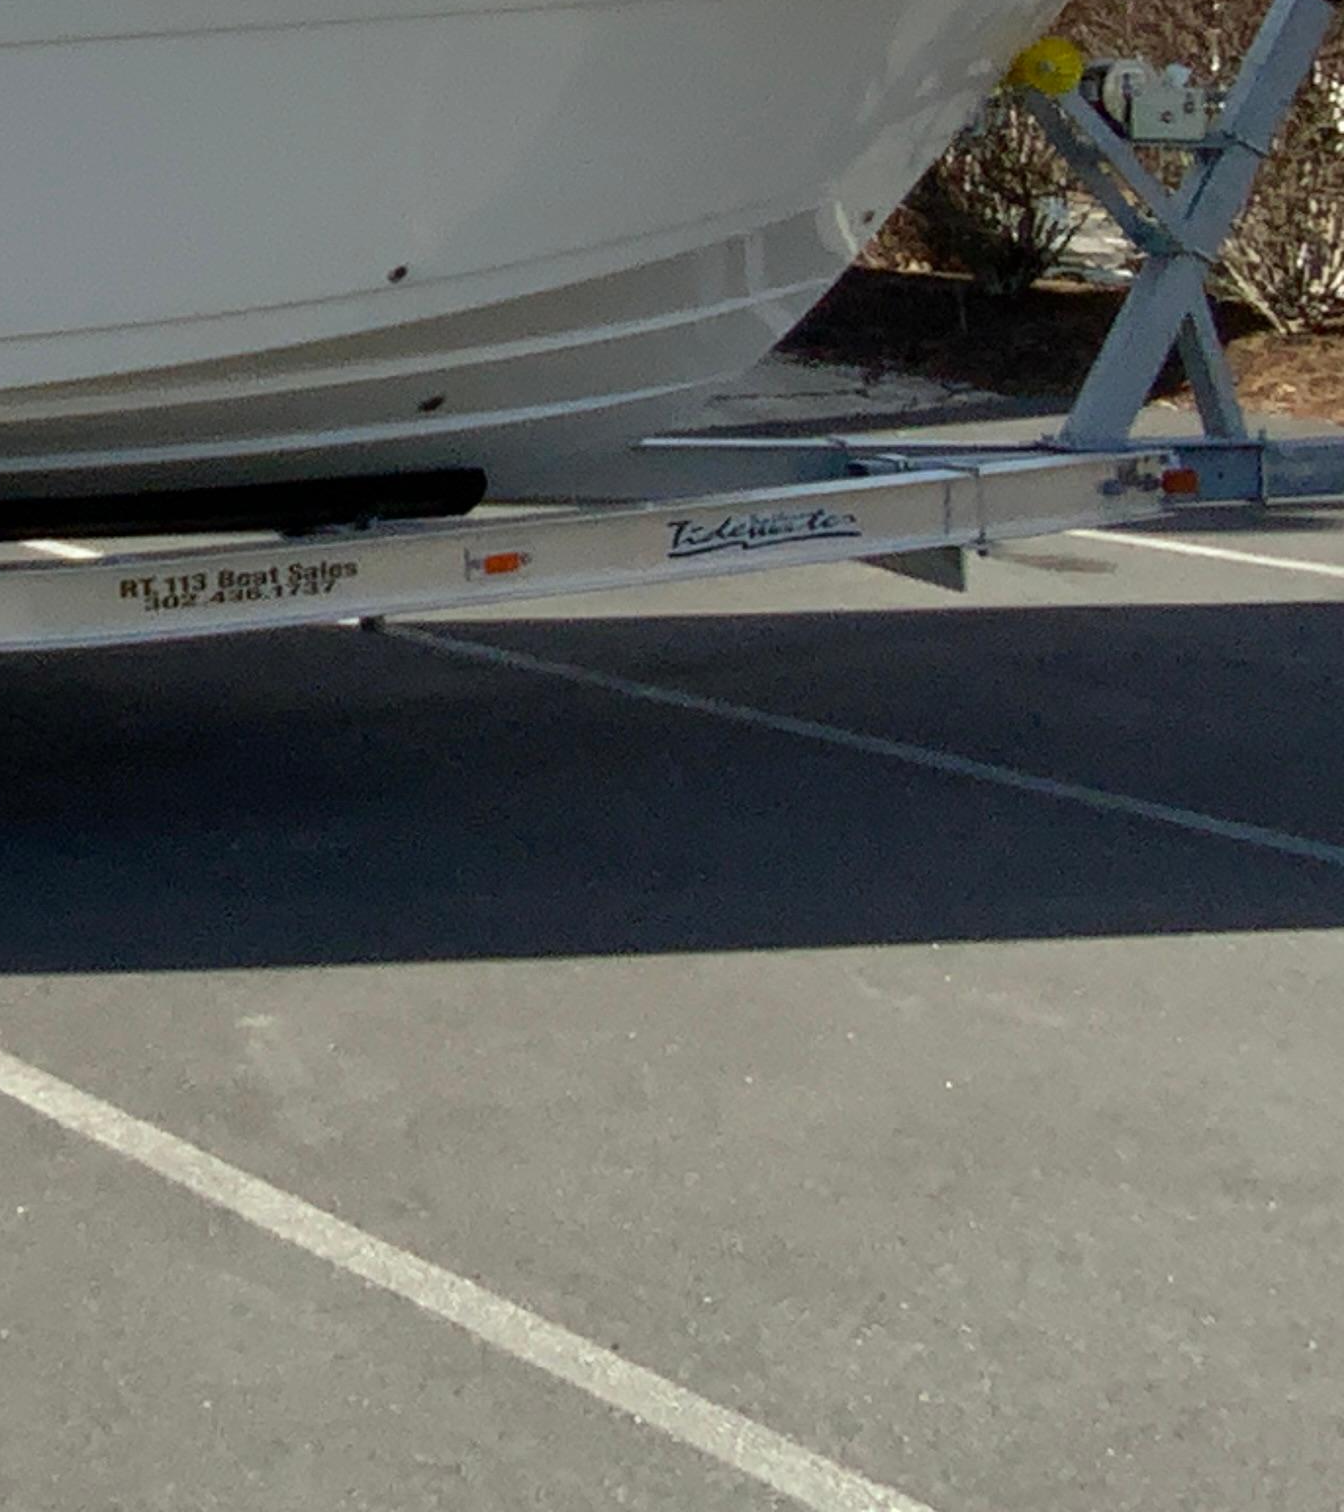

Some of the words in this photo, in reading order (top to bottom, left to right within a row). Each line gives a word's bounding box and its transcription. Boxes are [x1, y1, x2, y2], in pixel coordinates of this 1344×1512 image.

[164, 573, 207, 595] 113
[218, 566, 279, 589] Boat
[287, 560, 359, 583] Sales
